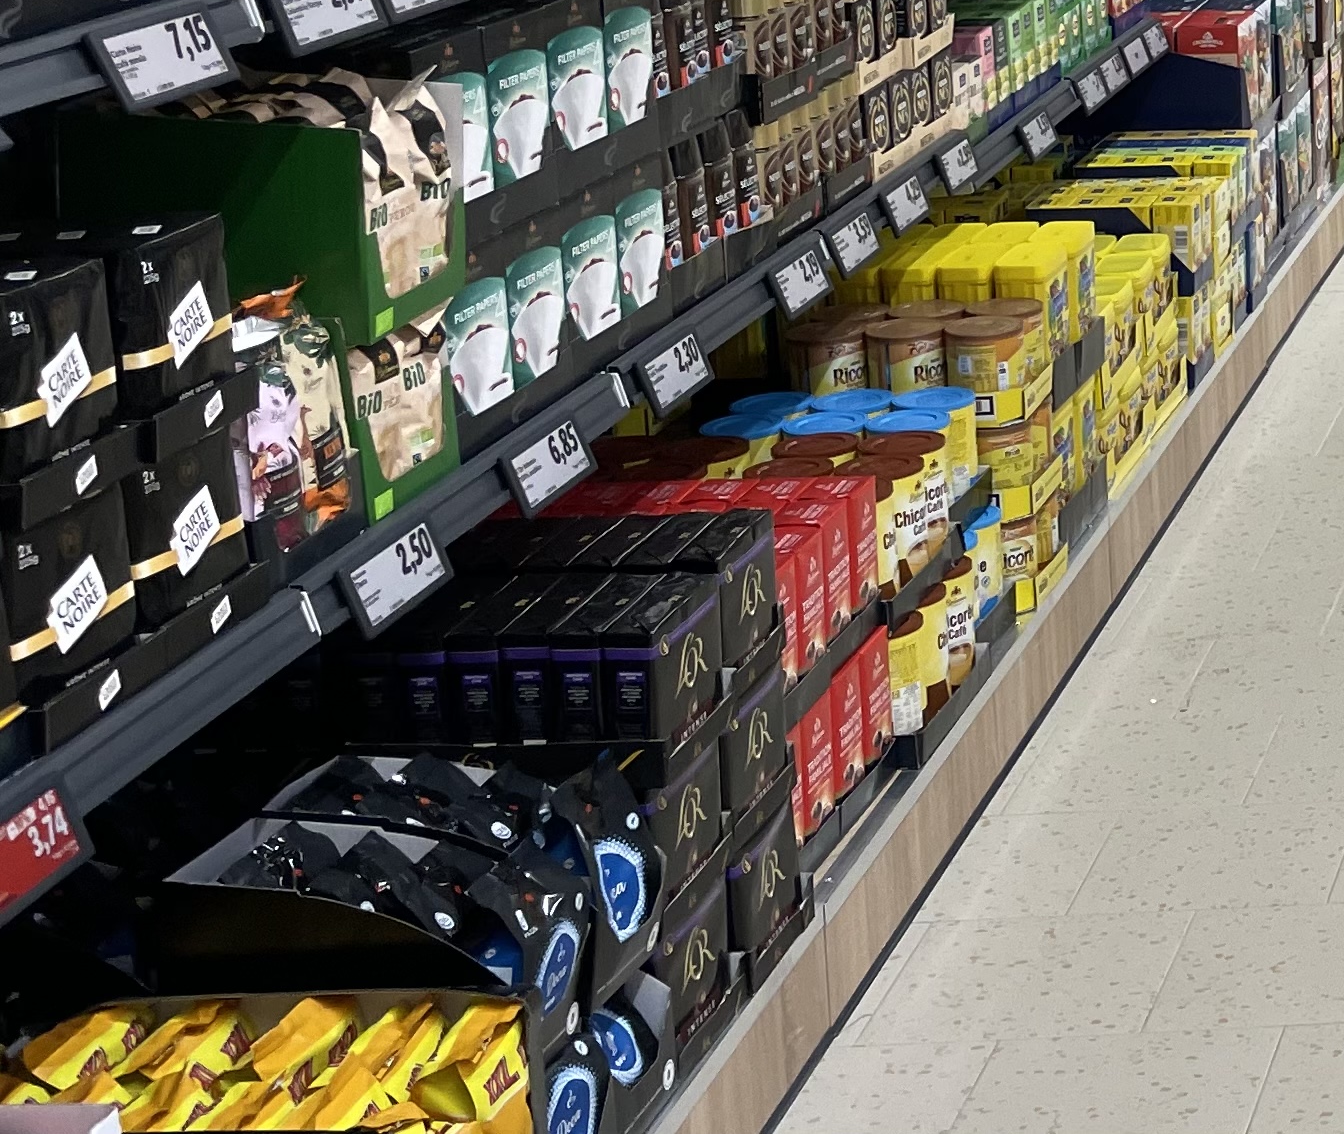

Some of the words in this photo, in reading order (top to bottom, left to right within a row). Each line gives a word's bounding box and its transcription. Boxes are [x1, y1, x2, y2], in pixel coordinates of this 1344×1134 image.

[164, 15, 212, 62] 7,15
[499, 73, 520, 90] FILTER
[140, 260, 154, 274] 2x
[173, 296, 203, 337] CARTE
[177, 310, 208, 353] NOIRE
[674, 335, 701, 375] 2,30
[548, 420, 581, 466] 6,85
[395, 527, 434, 576] 2,50
[56, 571, 96, 619] CARTE
[62, 585, 102, 635] NOIRE
[27, 805, 69, 858] 3,74
